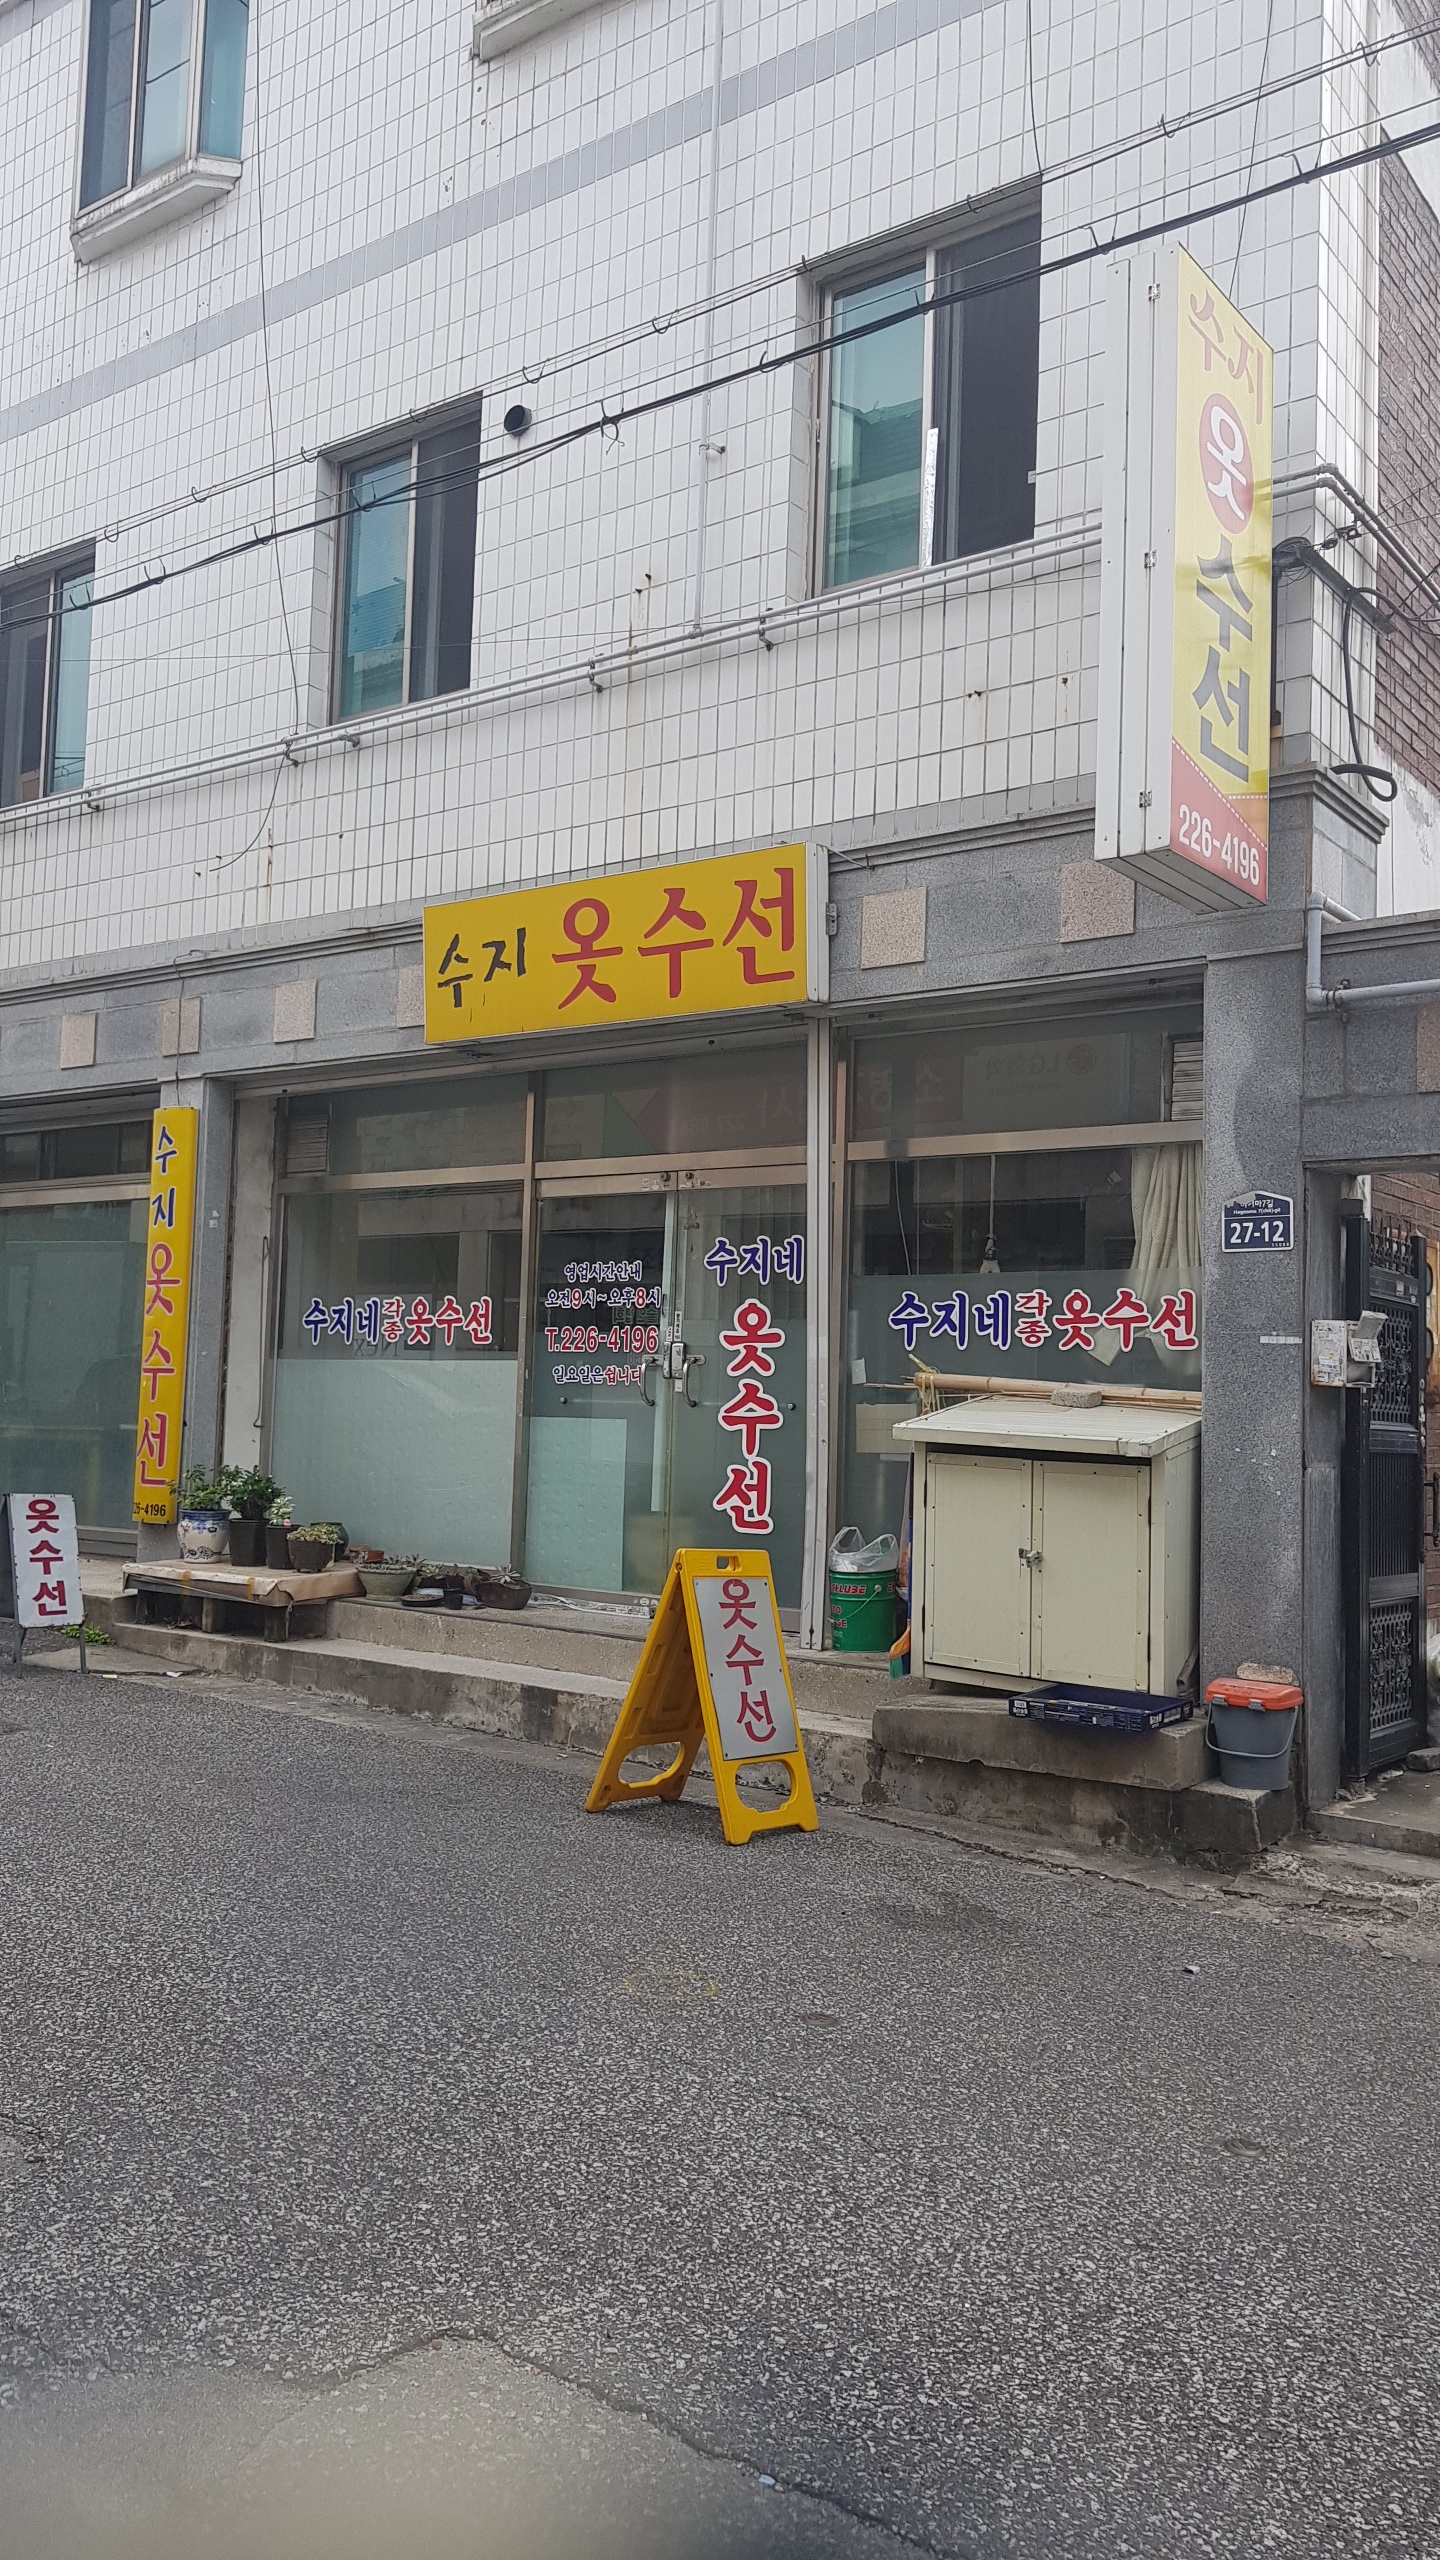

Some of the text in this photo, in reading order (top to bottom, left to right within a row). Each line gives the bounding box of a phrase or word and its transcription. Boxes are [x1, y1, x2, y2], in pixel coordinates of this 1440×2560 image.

[1188, 287, 1263, 426] 수지
[1179, 804, 1260, 886] 226-4196
[437, 866, 795, 1009] 수지 옷수선
[704, 1234, 804, 1287] 수지네
[1230, 1220, 1284, 1244] 27-12
[137, 1124, 181, 1487] 수지 옷수선
[302, 1296, 380, 1345] 수지네
[404, 1295, 494, 1345] 옷수선
[545, 1325, 659, 1353] T.226-4196
[888, 1290, 1012, 1351] 수지네
[1053, 1287, 1199, 1352] 옷수선
[713, 1298, 785, 1535] 옷수선
[25, 1498, 68, 1618] 옷수선
[718, 1578, 777, 1742] 옷수선
